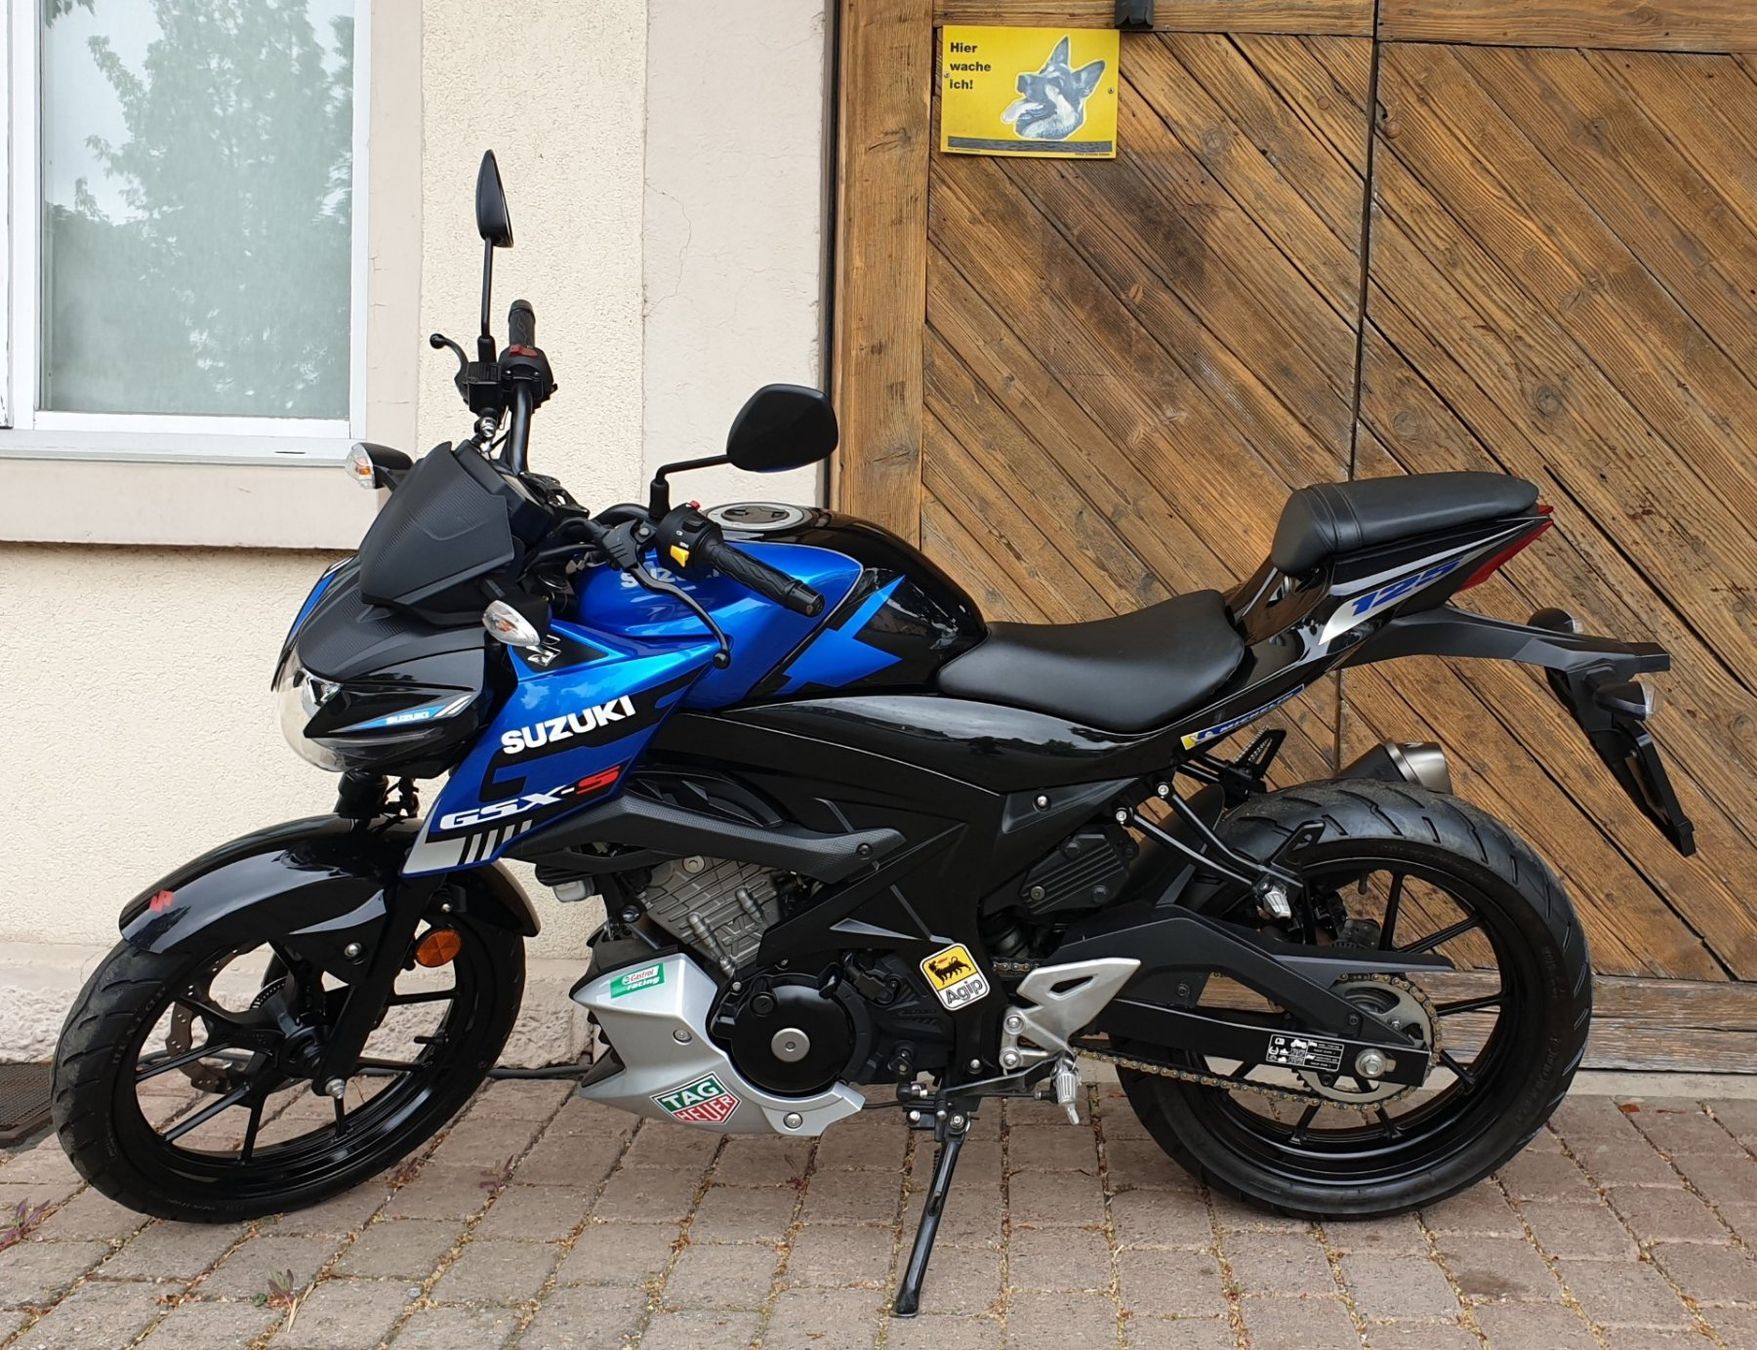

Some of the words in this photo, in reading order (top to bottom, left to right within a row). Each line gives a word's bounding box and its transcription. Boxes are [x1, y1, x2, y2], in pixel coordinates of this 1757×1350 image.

[950, 42, 978, 53] Hier
[950, 62, 992, 72] wache
[949, 79, 973, 89] ich!
[1352, 556, 1464, 617] 125
[501, 695, 636, 755] SUZUKI
[440, 765, 621, 830] GSX-S
[945, 979, 983, 1004] Agip
[661, 1081, 720, 1109] TAG
[676, 1095, 733, 1121] HEUER
